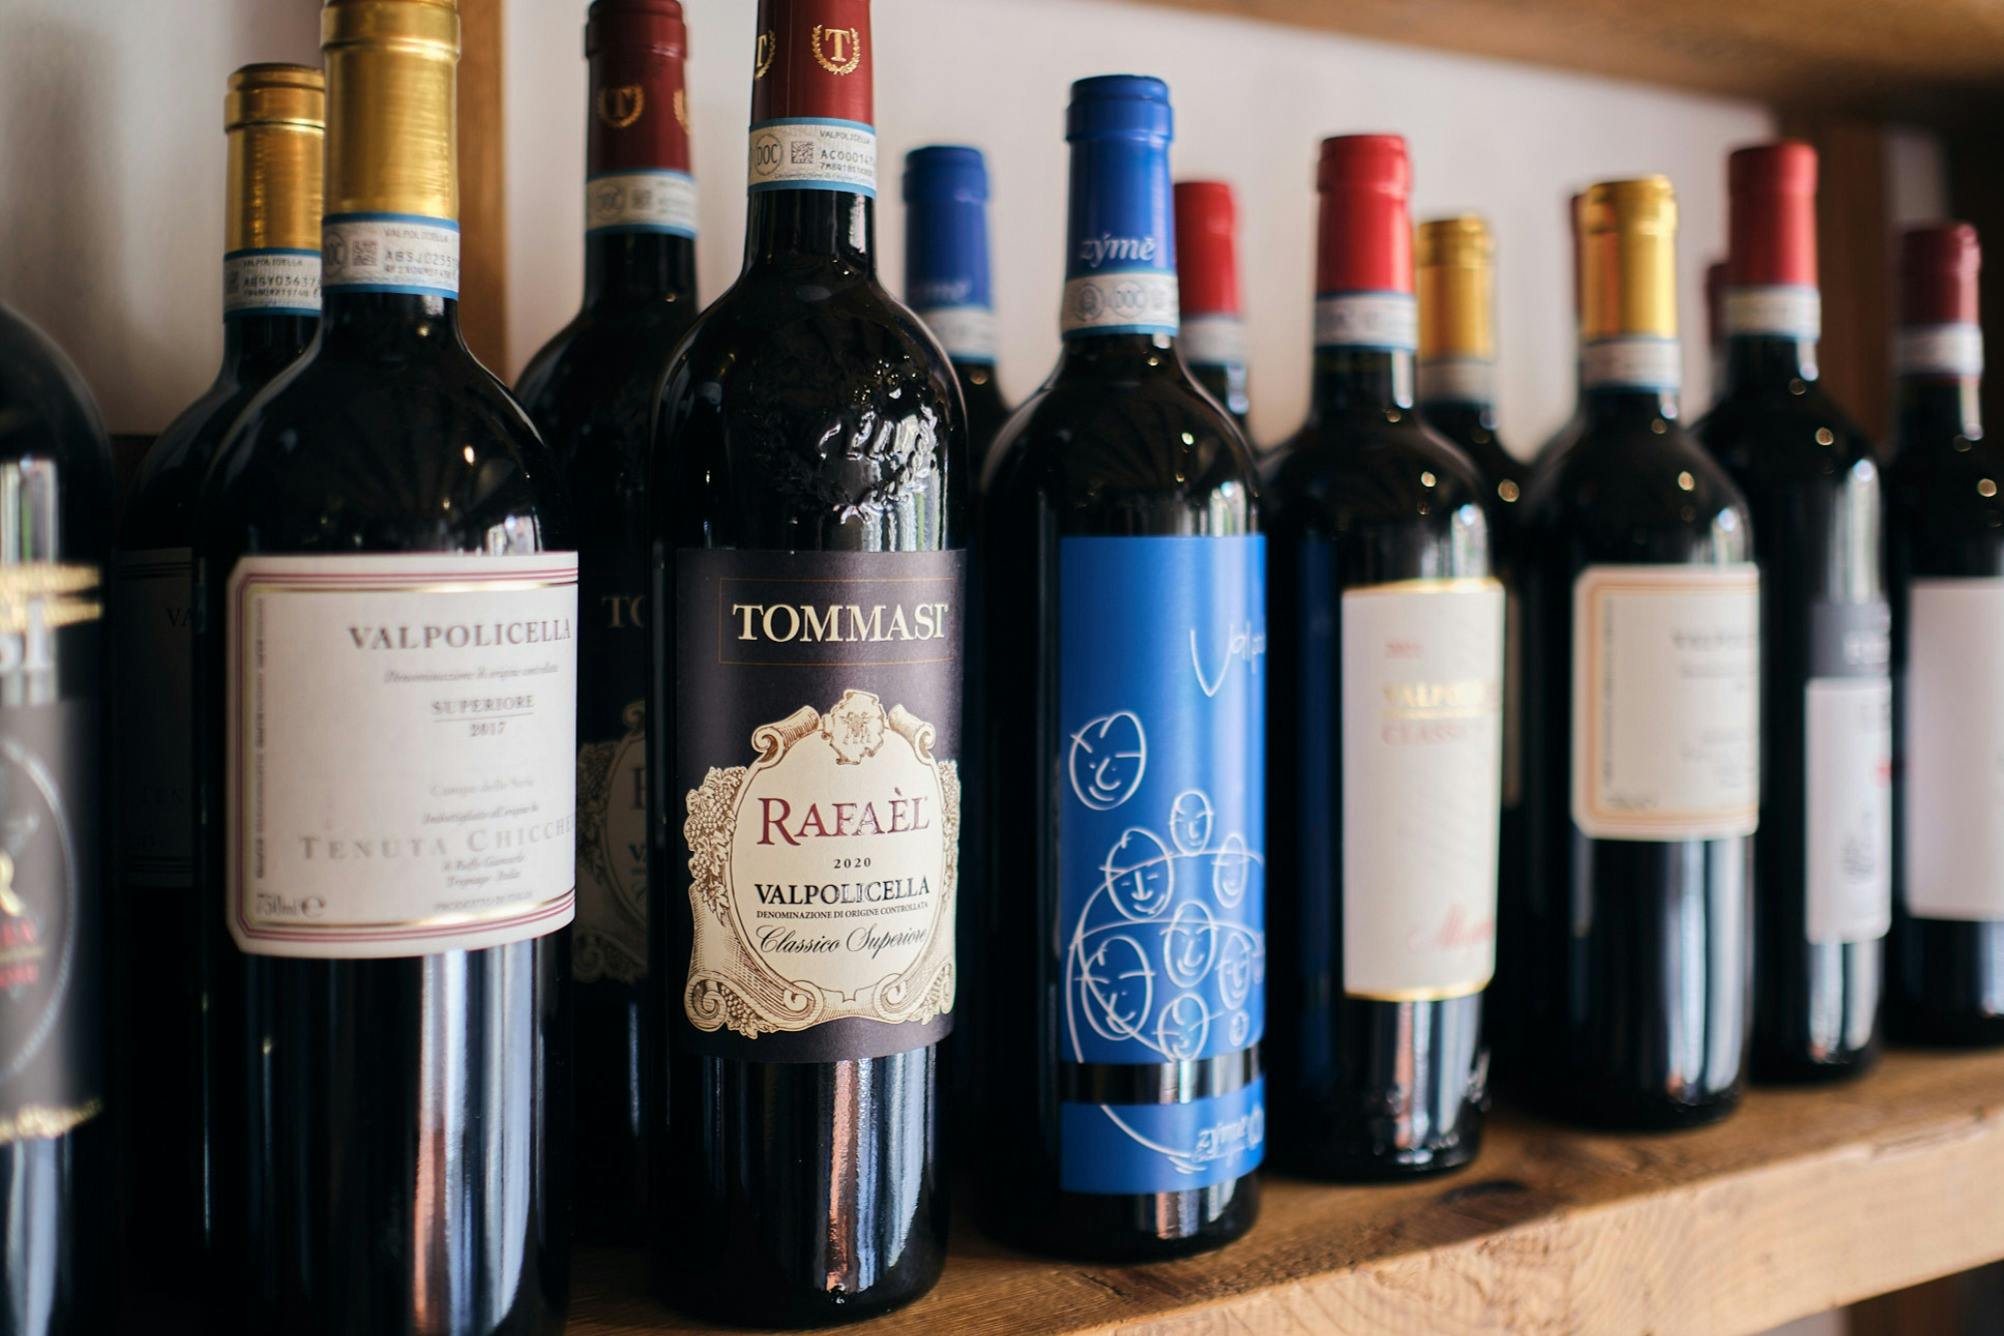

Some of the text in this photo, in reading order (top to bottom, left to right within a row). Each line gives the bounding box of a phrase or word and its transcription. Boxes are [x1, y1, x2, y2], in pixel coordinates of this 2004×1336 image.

[824, 28, 850, 62] T
[348, 617, 572, 651] VALPOLICELLA
[732, 603, 948, 643] TOMMASI
[431, 694, 536, 716] SUPERIORE
[756, 786, 930, 847] RAFAÈL
[299, 834, 447, 861] TENUTA
[833, 857, 872, 870] 2020
[754, 874, 930, 906] VALPOLICELLA
[756, 900, 928, 920] DENOMINAZIONE DI ORIGINE CONTROLLATA
[755, 922, 928, 960] Classico Superiore
